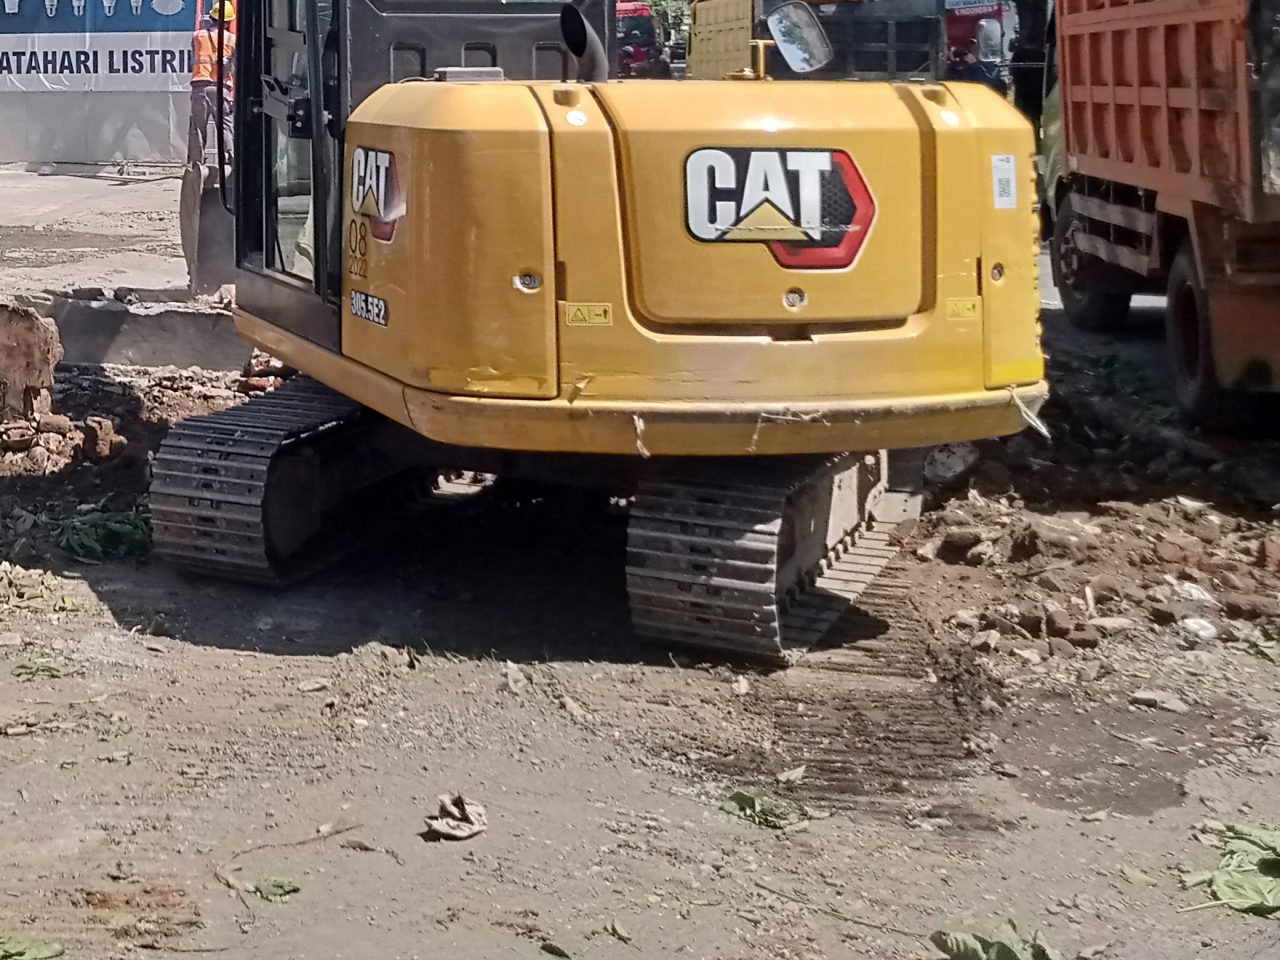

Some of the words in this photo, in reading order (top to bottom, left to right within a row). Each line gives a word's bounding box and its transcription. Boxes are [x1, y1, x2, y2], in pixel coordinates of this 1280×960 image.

[352, 147, 390, 218] CAT
[686, 149, 832, 241] CAT
[348, 219, 367, 258] 08
[349, 255, 368, 279] 2022
[351, 290, 387, 326] 305.5E2
